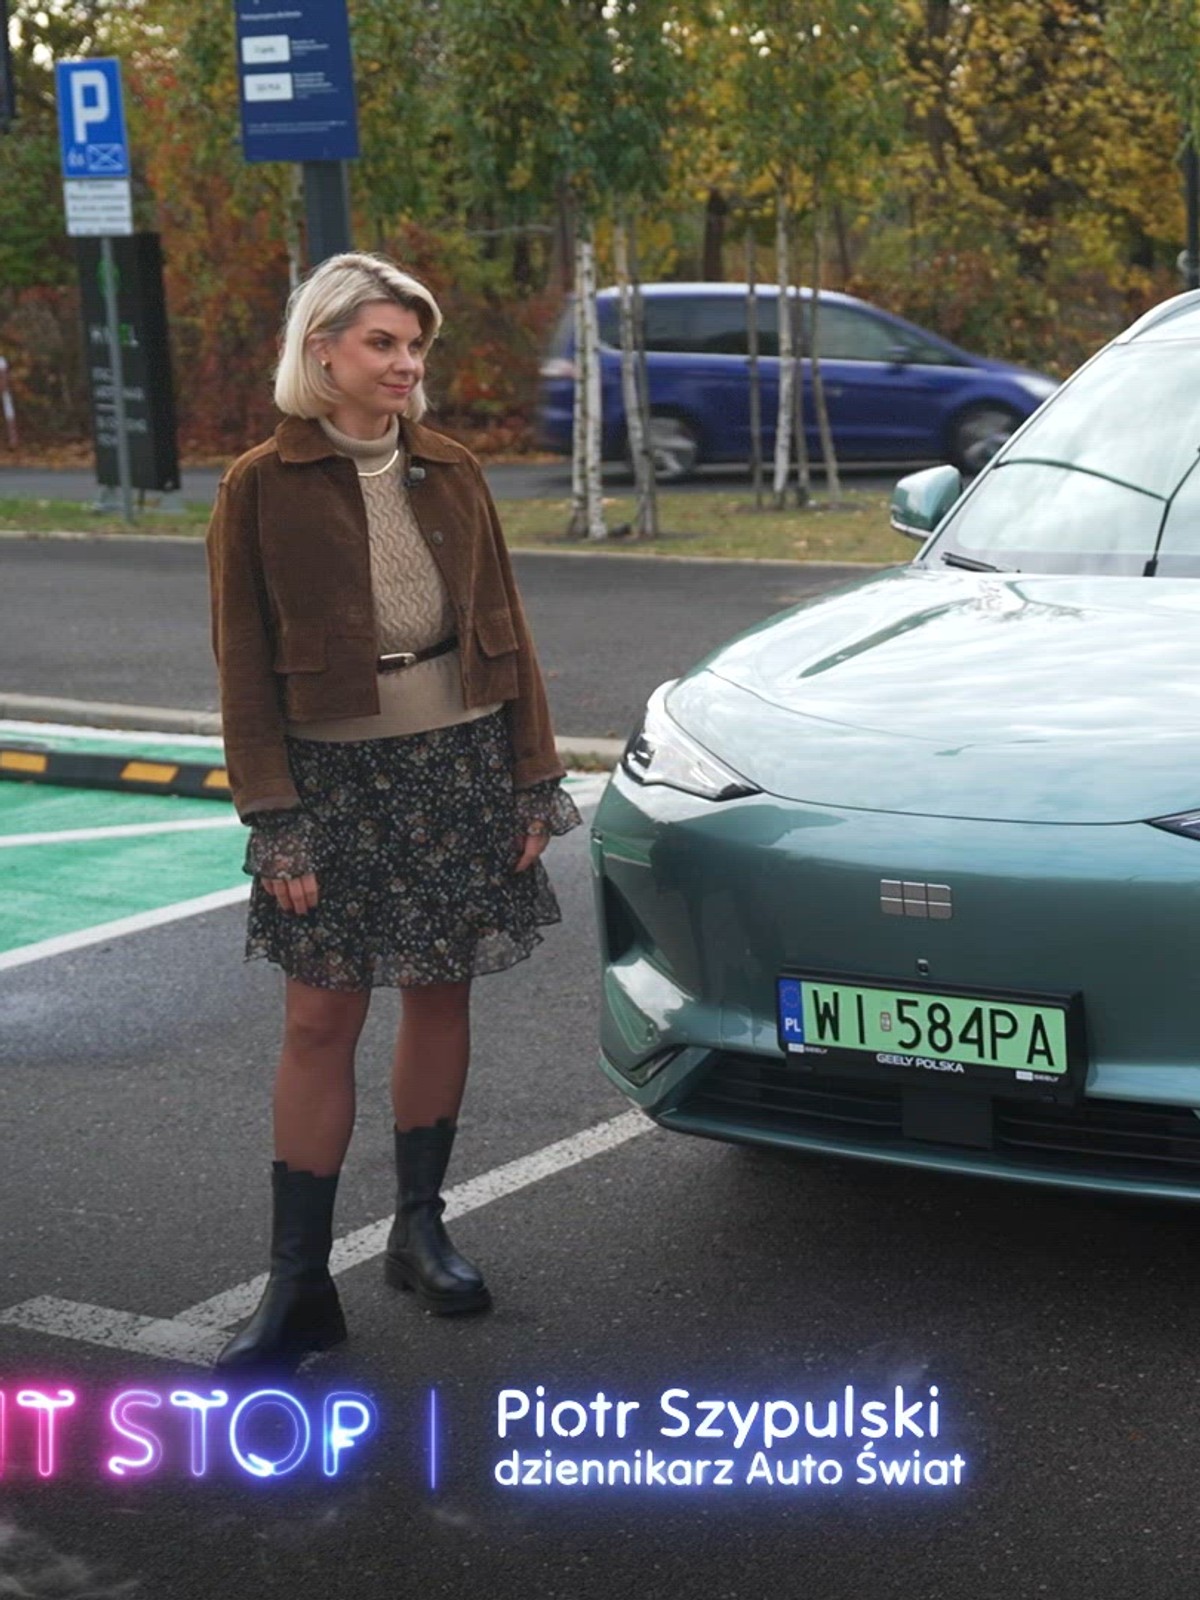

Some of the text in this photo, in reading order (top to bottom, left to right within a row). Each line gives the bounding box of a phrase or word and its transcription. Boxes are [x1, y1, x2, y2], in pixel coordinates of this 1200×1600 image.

[70, 69, 110, 144] P
[784, 1016, 802, 1033] PL
[812, 989, 1056, 1067] WI 584PA
[876, 1053, 965, 1074] GEELY POLSKA
